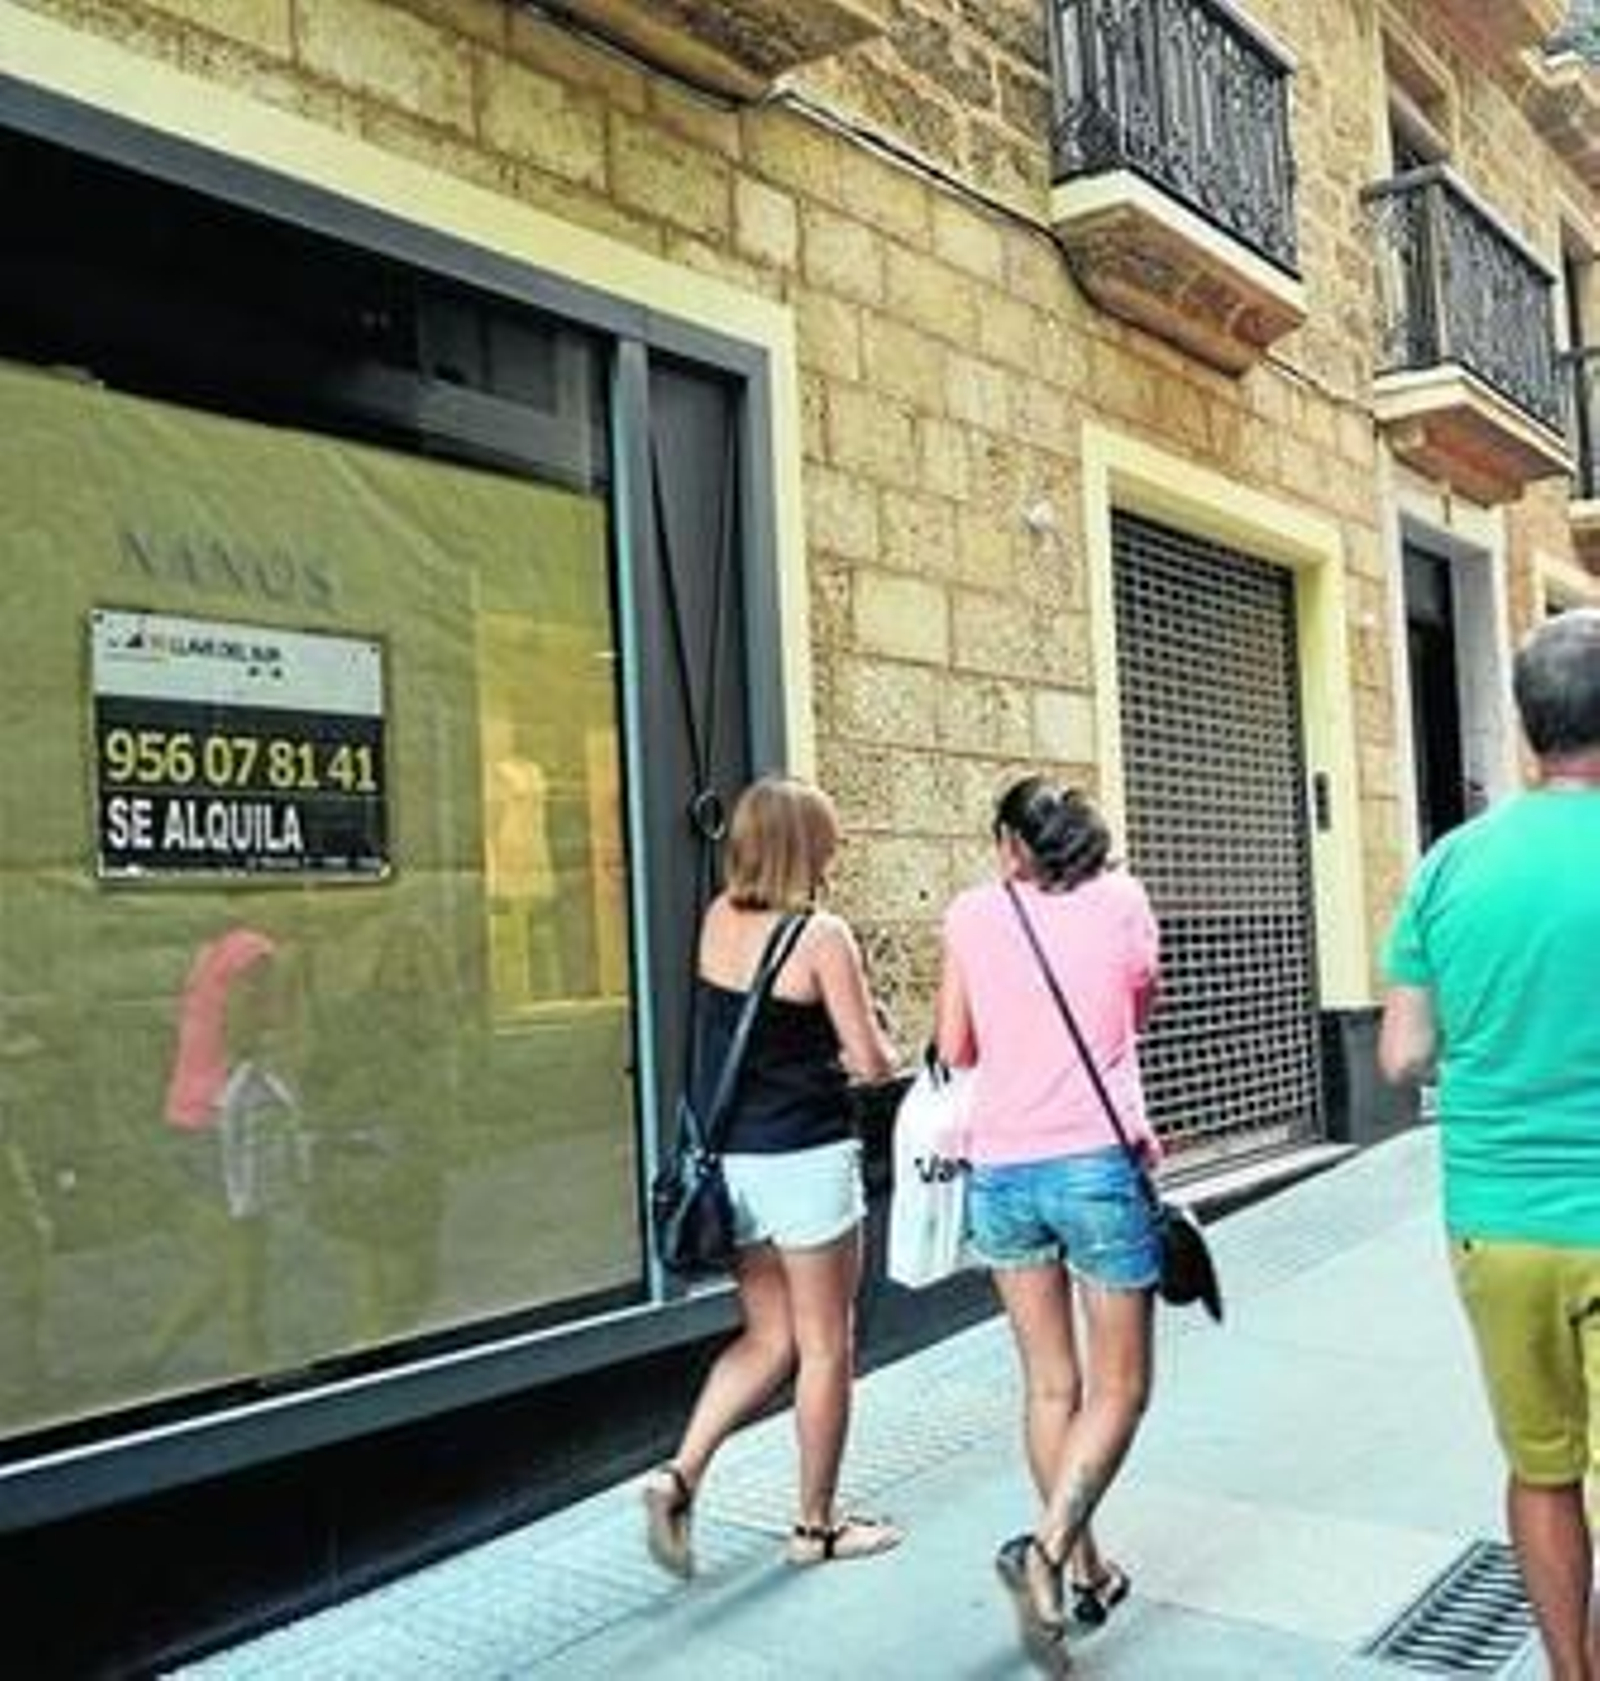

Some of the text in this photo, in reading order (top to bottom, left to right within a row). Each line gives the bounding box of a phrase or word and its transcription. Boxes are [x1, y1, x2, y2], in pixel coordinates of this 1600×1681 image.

[106, 729, 377, 792] 956 07 81 41
[107, 797, 303, 853] SE ALQUILA
